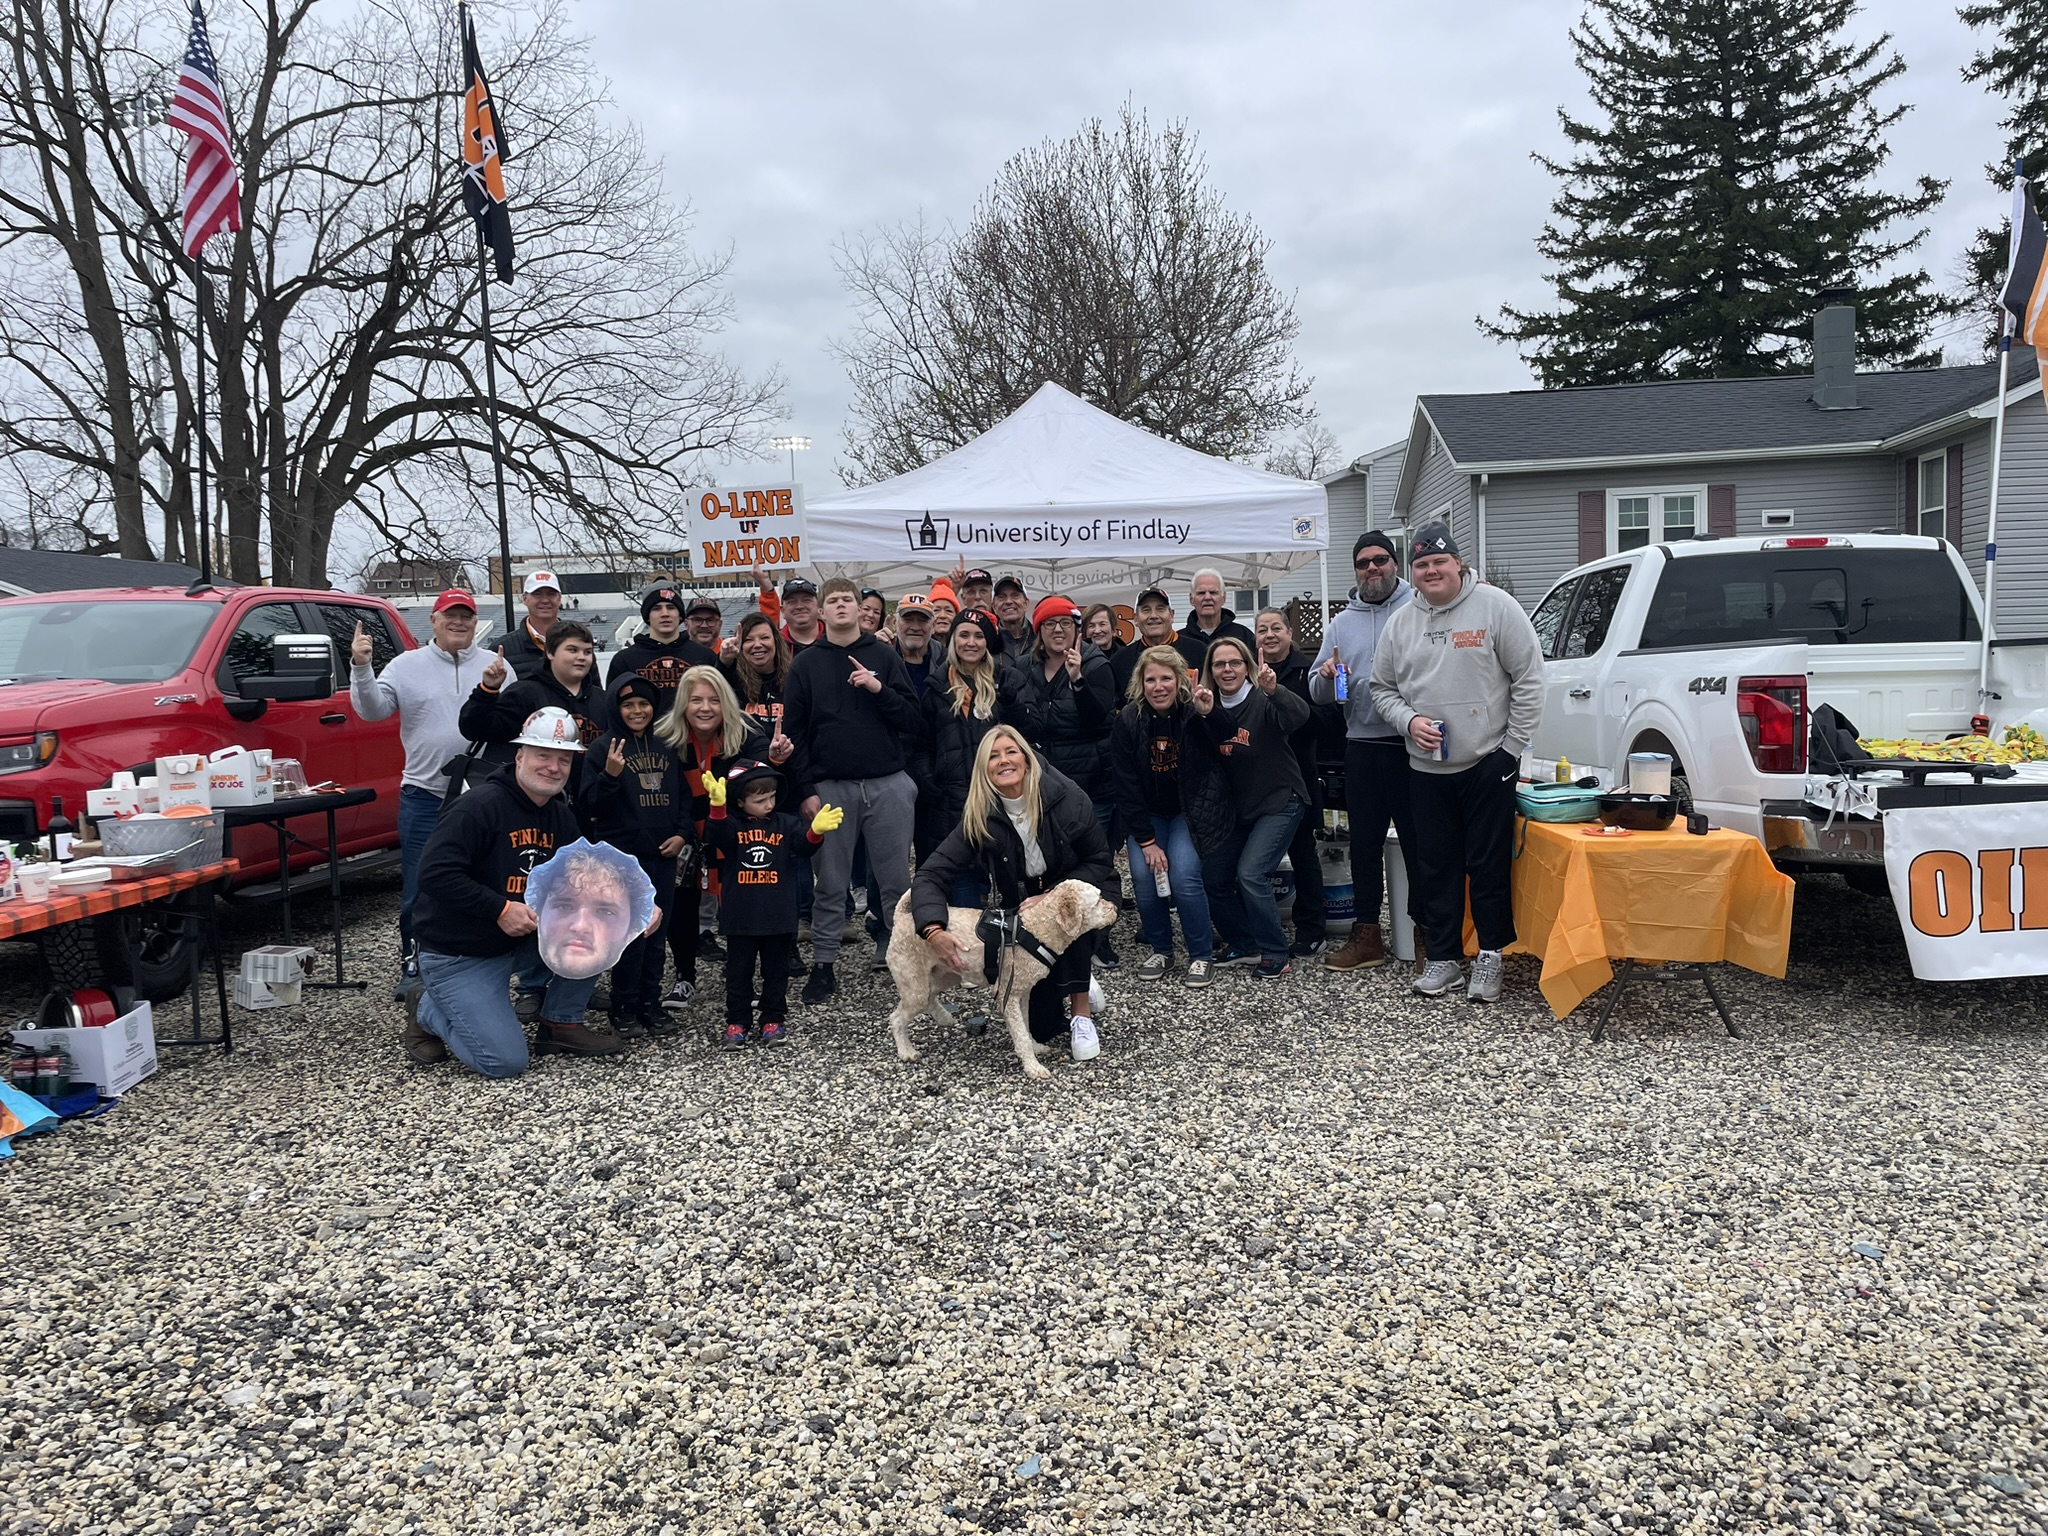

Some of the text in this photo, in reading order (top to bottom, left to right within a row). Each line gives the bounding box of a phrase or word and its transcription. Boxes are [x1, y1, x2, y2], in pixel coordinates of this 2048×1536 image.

[701, 489, 794, 521] O-LINE
[739, 520, 760, 535] UF
[956, 518, 1191, 547] University of Findlay
[702, 536, 801, 568] NATION
[1452, 629, 1487, 643] FINDLAY
[1688, 676, 1727, 696] 4x4
[626, 756, 670, 774] FINDLAY
[737, 828, 784, 846] FINDLAY
[752, 850, 765, 863] 77
[737, 870, 779, 884] OILERS
